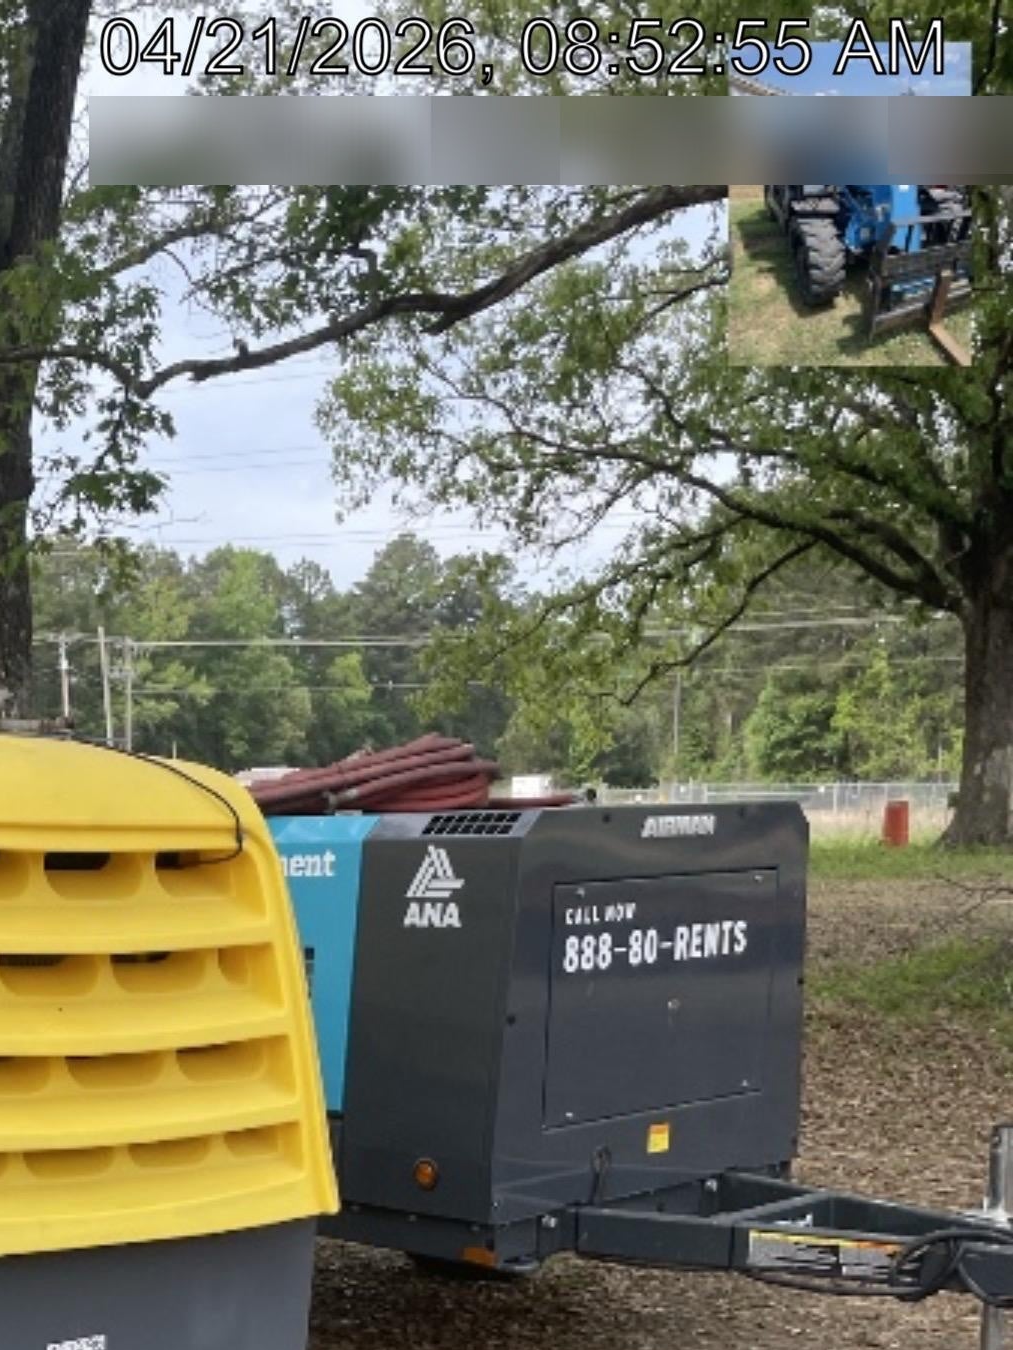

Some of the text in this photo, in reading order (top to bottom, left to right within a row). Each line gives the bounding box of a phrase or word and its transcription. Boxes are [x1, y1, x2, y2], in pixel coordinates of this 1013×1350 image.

[640, 814, 716, 838] AIRMAN
[403, 902, 462, 929] ANA
[564, 902, 637, 926] CALL NOW
[563, 920, 748, 973] 888-80-RENTS
